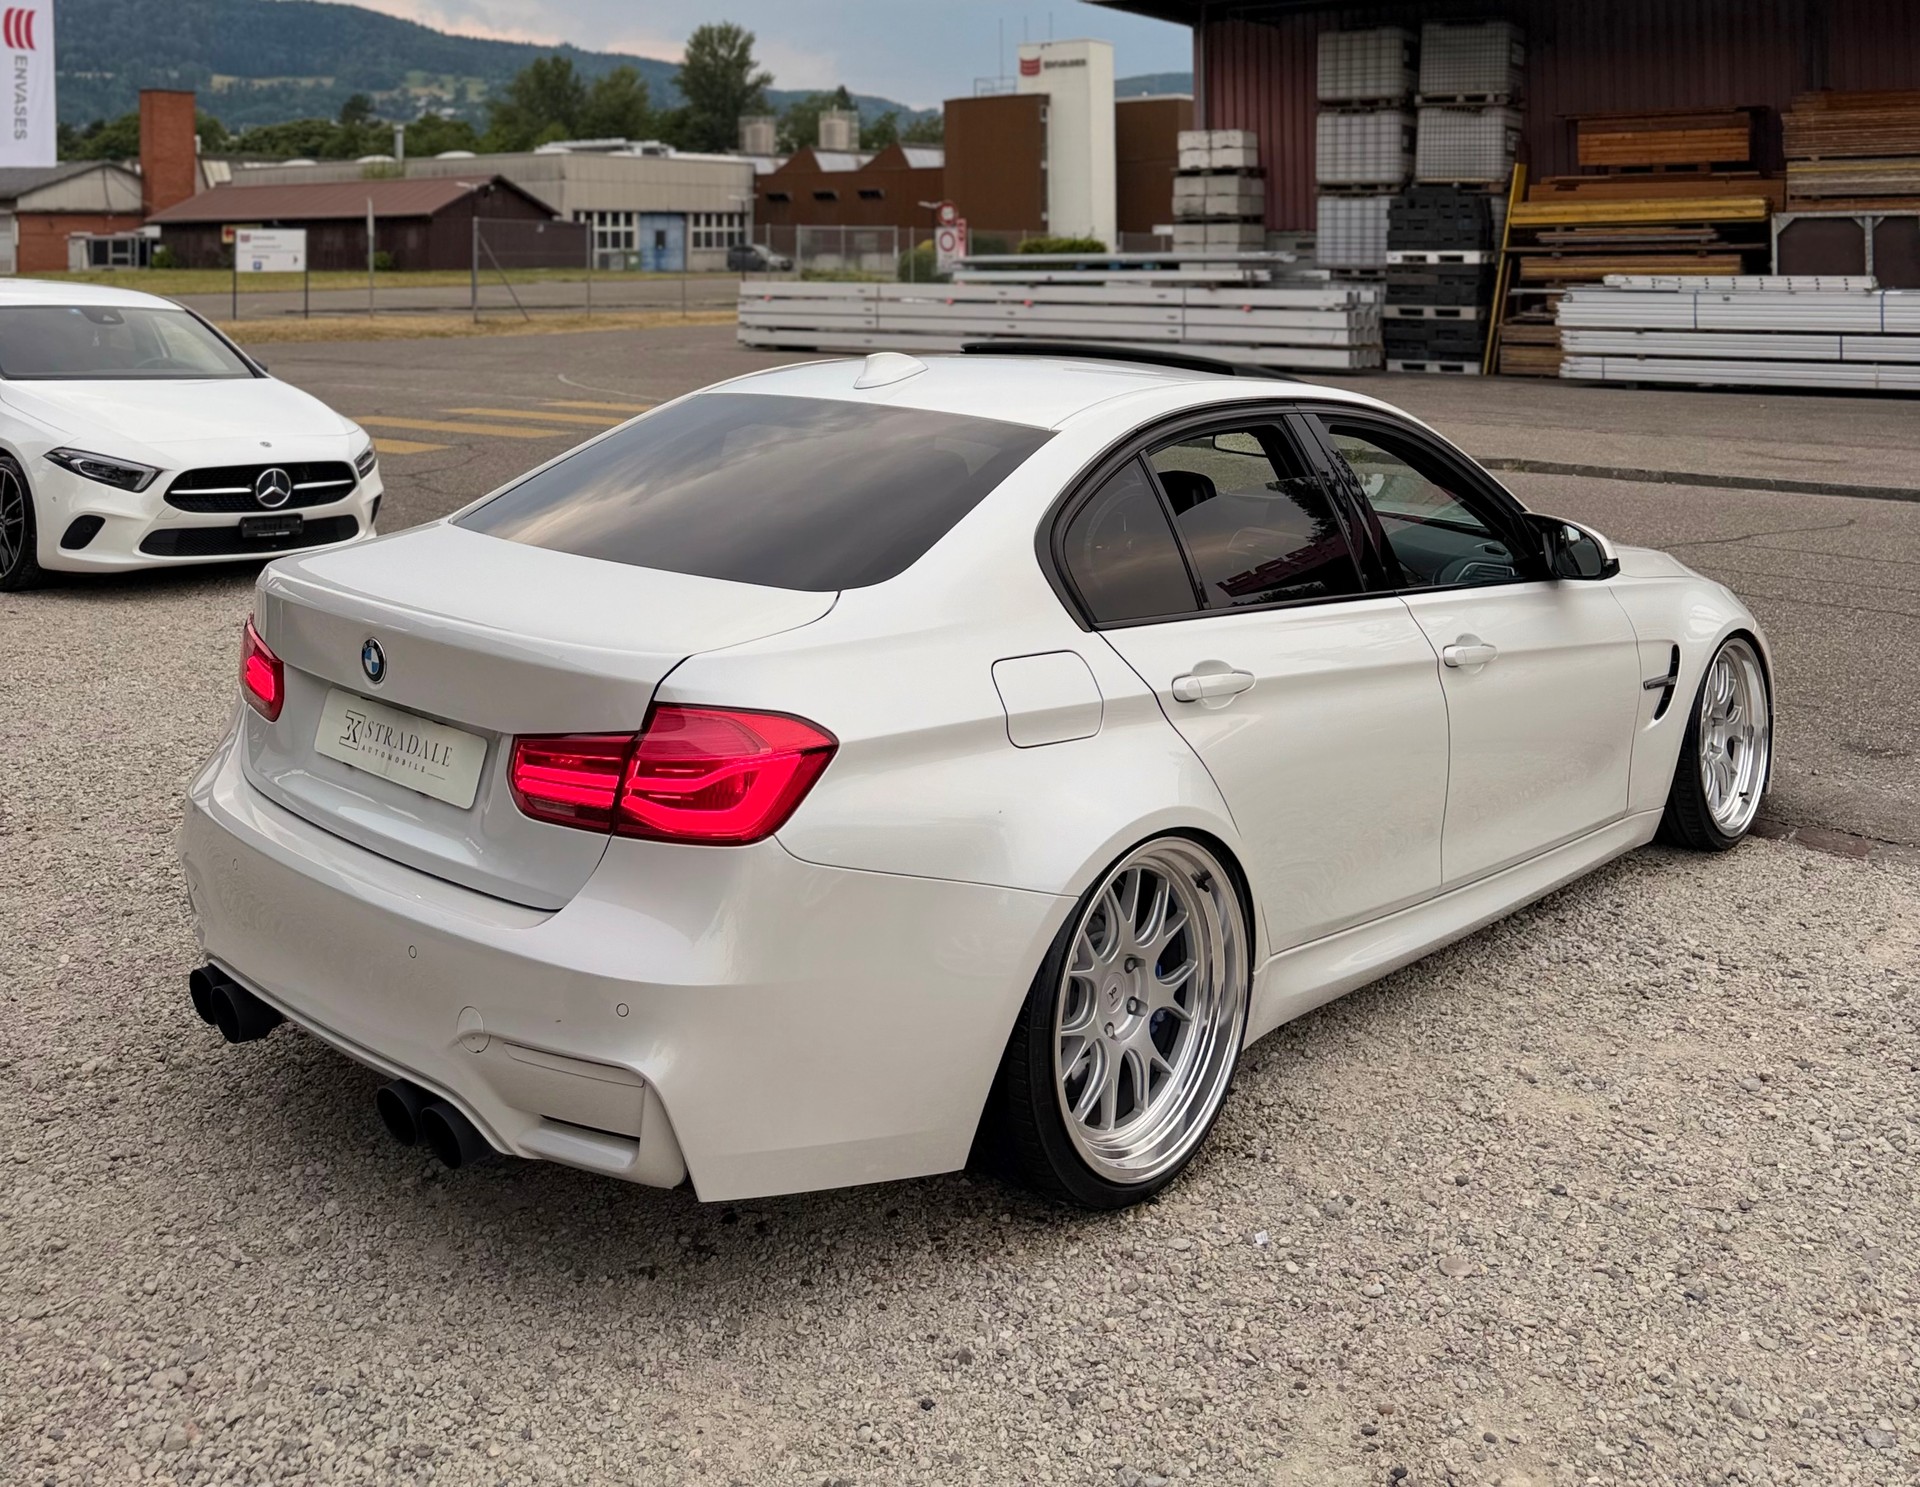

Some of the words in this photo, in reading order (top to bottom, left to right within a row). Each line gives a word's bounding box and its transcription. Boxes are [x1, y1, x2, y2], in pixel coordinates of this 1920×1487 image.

[14, 55, 27, 140] ENVASES
[361, 745, 425, 773] AUTOMOBILE
[364, 720, 452, 767] STRADALE
